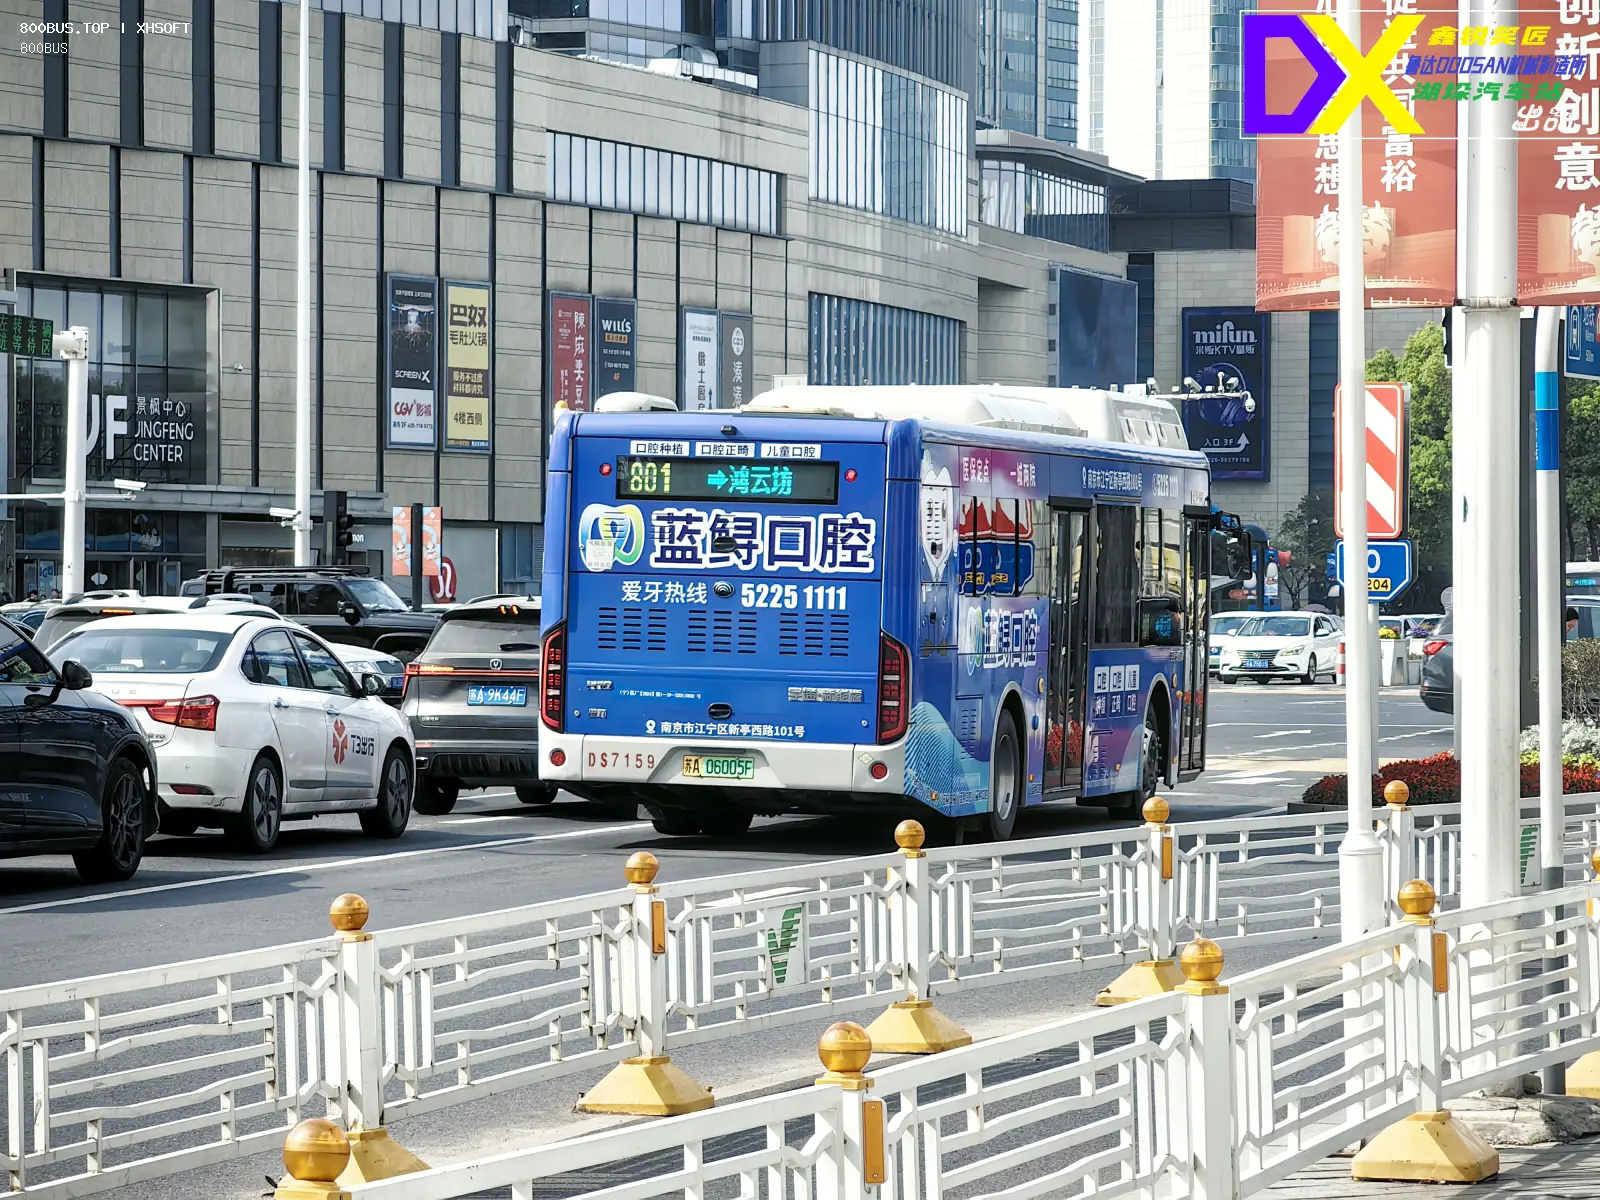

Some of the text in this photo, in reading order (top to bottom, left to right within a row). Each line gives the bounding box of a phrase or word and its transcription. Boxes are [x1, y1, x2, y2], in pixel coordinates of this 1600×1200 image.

[449, 303, 488, 329] 巴奴
[449, 330, 488, 347] 毛肚火锅
[136, 396, 187, 417] 景枫中心
[453, 411, 483, 426] 4楼西侧
[134, 420, 194, 441] JINGFENG
[635, 443, 684, 455] 口腔种植
[701, 444, 749, 457] 口腔正畸
[766, 445, 816, 458] 儿童口腔
[1204, 437, 1220, 446] 入口
[133, 443, 184, 463] CENTER
[630, 462, 671, 494] 801
[962, 457, 990, 483] 医保定点
[728, 465, 793, 496] 鸿云坊
[621, 580, 708, 604] 爱牙热线
[741, 583, 847, 610] 5225 1111
[660, 721, 806, 738] 南京市江宁区新亭西路101号
[588, 752, 655, 769] DS7159
